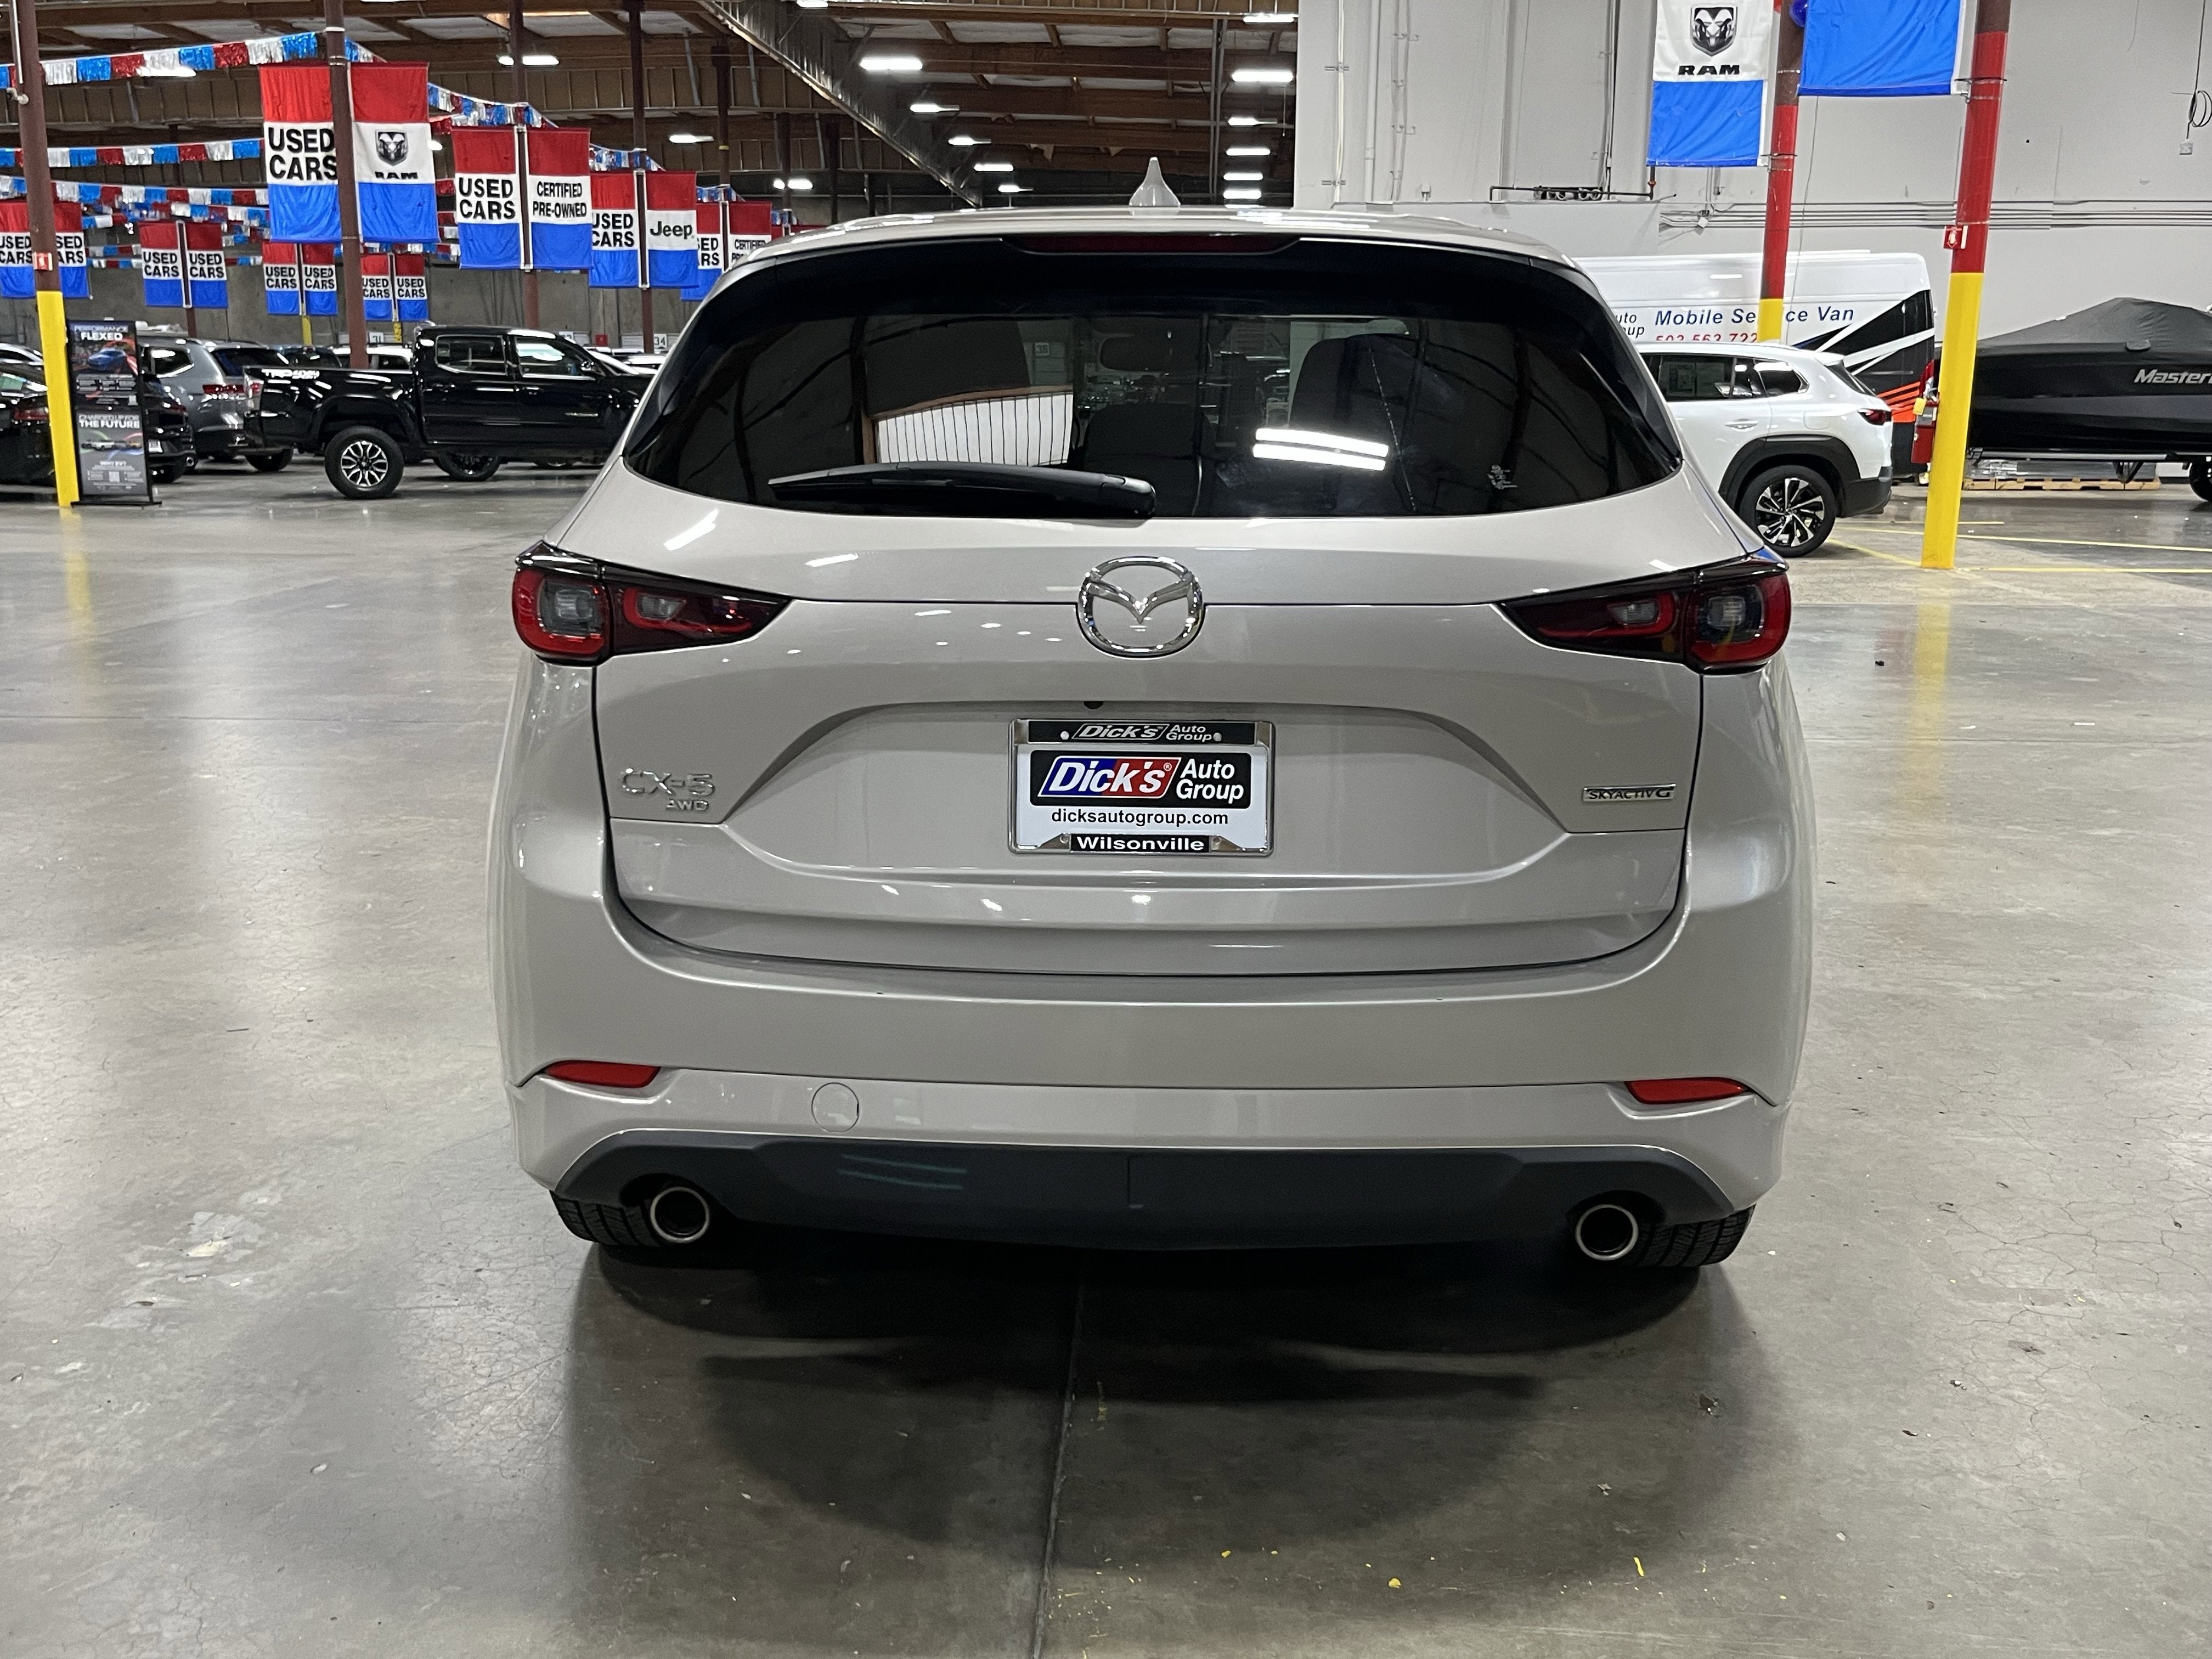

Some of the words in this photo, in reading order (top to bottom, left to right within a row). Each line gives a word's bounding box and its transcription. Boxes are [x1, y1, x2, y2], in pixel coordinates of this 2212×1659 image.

[1678, 65, 1740, 75] RAM
[268, 127, 335, 153] USED
[269, 155, 337, 180] CARS
[459, 177, 514, 198] USED
[537, 181, 582, 198] CERTIFIED
[460, 199, 516, 220] CARS
[533, 201, 587, 218] PRE-OWNED
[650, 221, 692, 240] Jeep
[56, 236, 82, 249] SED
[592, 231, 635, 247] CARS
[697, 238, 719, 251] ED
[58, 251, 83, 264] ARS
[143, 252, 177, 263] USED
[189, 253, 222, 265] USED
[144, 266, 179, 277] CARS
[190, 266, 224, 278] CARS
[266, 267, 295, 277] USED
[305, 267, 334, 278] USED
[266, 278, 297, 289] CARS
[305, 279, 335, 289] CARS
[363, 278, 388, 287] USED
[397, 278, 424, 287] USED
[363, 289, 390, 298] CARS
[398, 289, 425, 298] CARS
[1655, 309, 1723, 325] Mobile
[1731, 308, 1808, 324] Sece
[1818, 306, 1854, 321] Van
[81, 332, 123, 341] FLEXED
[101, 420, 140, 428] FUTURE
[1079, 725, 1158, 738] Dick's
[1170, 724, 1206, 733] Auto
[1166, 732, 1212, 742] Group
[1048, 760, 1165, 793] Dick's
[1181, 758, 1235, 780] Auto
[622, 768, 715, 797] CX-5
[1176, 779, 1244, 804] Group
[1052, 809, 1228, 827] dicksautogroup.com
[1076, 836, 1204, 851] Wilsonville
